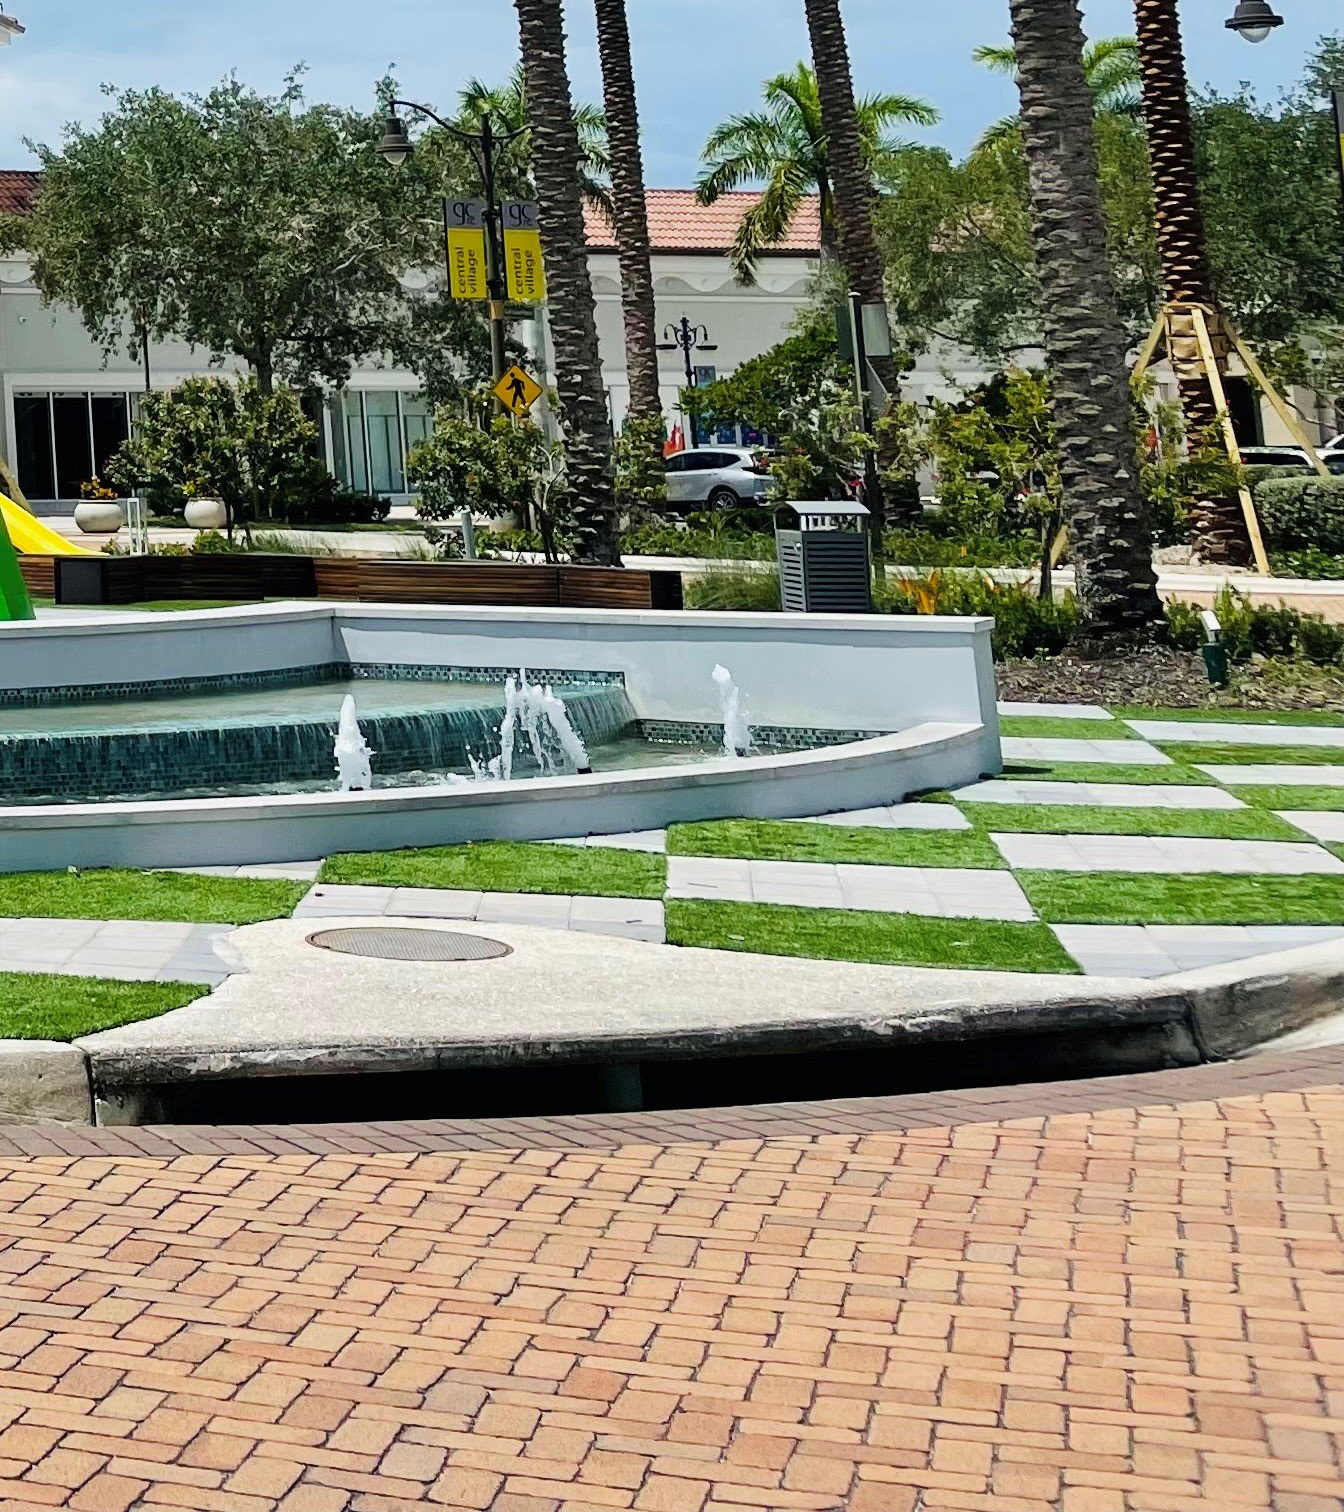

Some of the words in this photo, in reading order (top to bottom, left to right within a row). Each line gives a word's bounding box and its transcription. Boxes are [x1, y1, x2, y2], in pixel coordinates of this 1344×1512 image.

[453, 202, 475, 225] gc
[509, 203, 532, 226] gc
[455, 246, 466, 294] central
[467, 248, 478, 294] village
[512, 247, 523, 295] central
[524, 249, 535, 295] village
